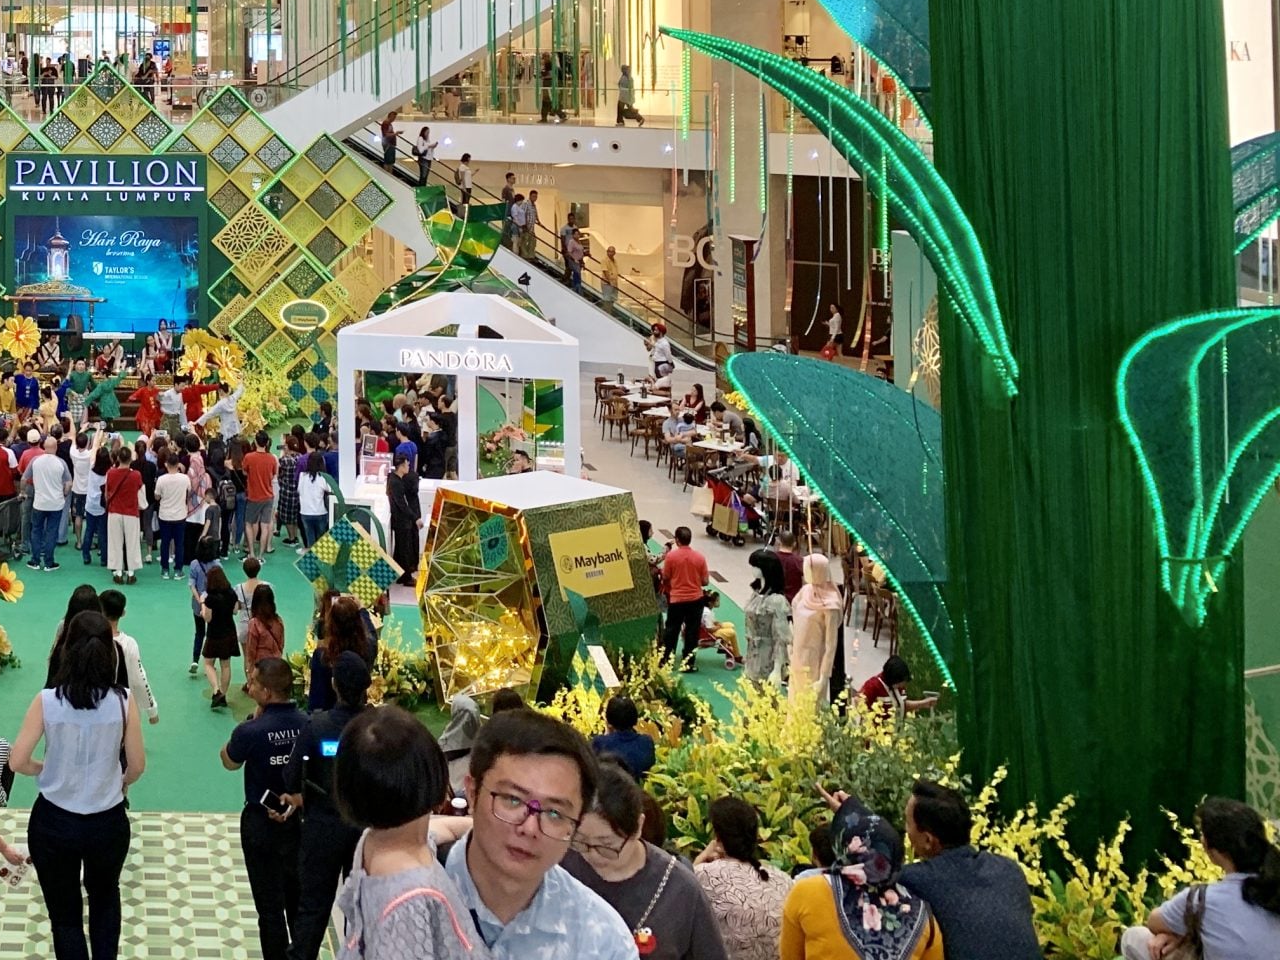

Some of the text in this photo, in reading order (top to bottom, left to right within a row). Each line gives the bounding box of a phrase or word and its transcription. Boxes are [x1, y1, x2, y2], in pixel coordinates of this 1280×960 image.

[15, 159, 197, 187] PAVILION
[22, 191, 192, 202] KUALA LUMPUR
[79, 229, 162, 254] Hari Raya
[104, 266, 135, 275] TAYLOR'S
[574, 548, 624, 568] Maybank
